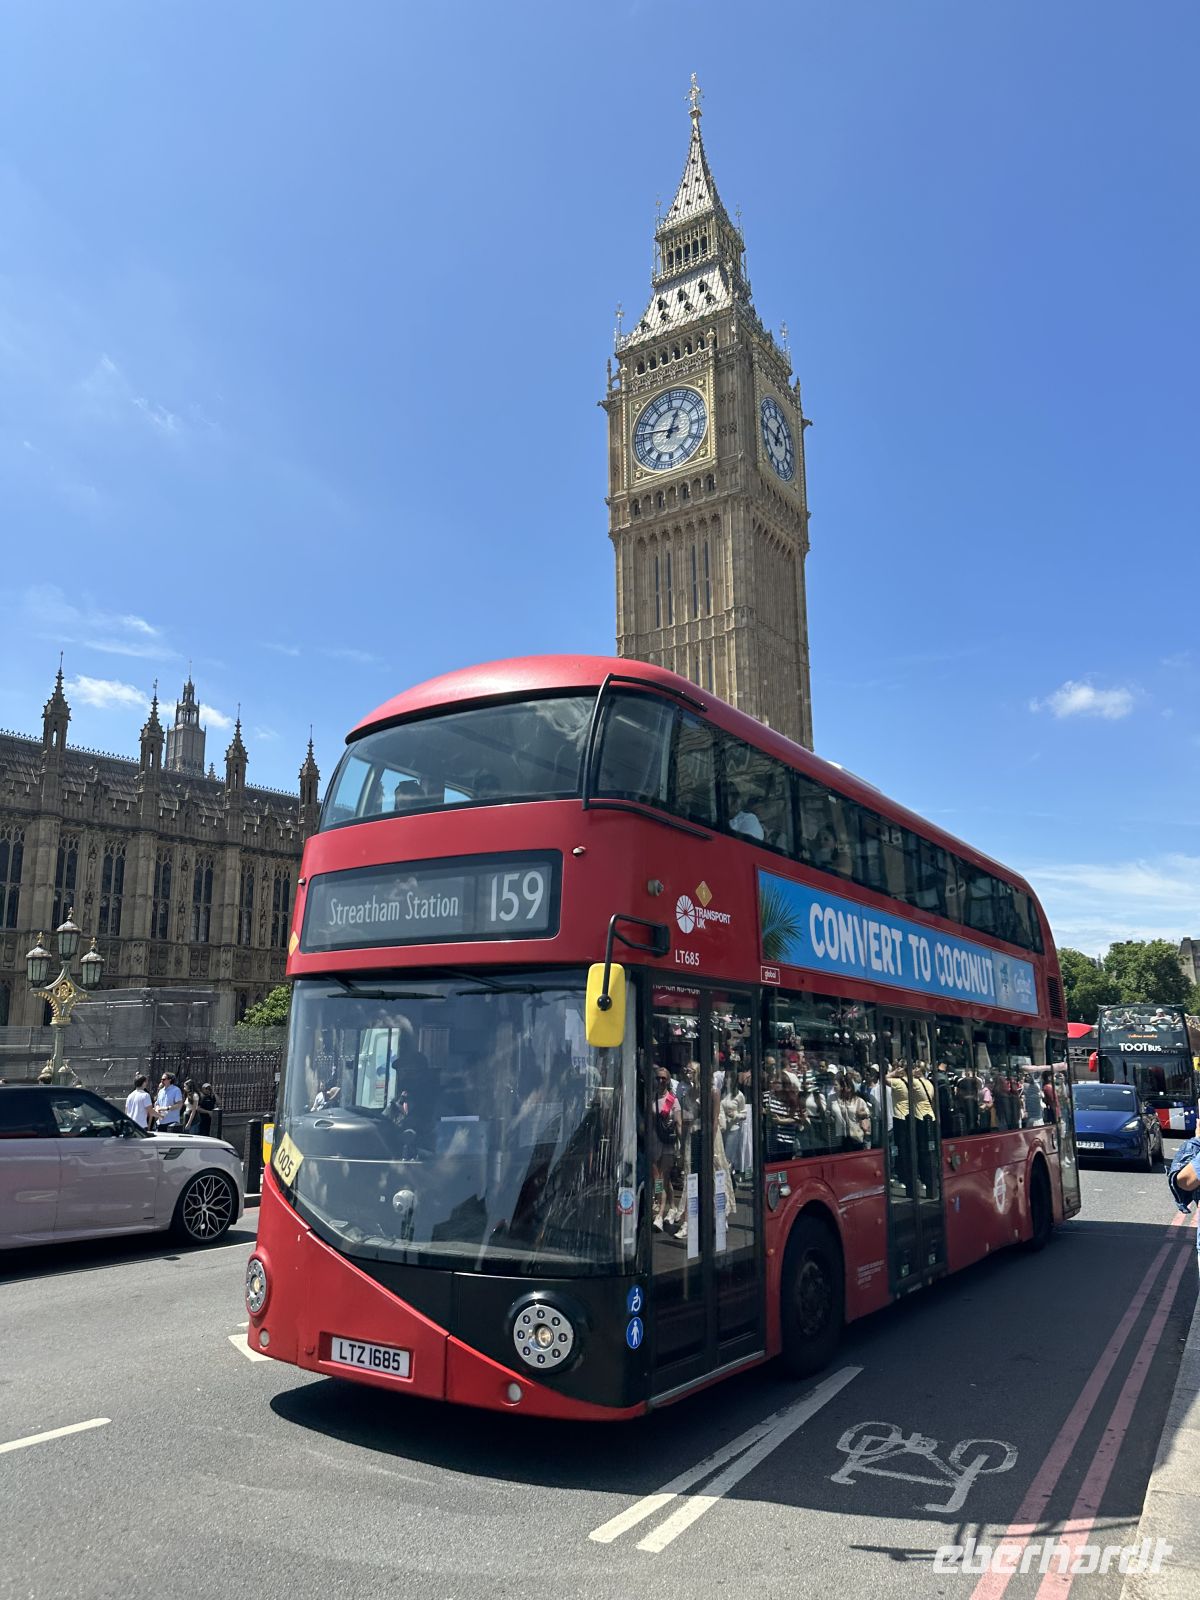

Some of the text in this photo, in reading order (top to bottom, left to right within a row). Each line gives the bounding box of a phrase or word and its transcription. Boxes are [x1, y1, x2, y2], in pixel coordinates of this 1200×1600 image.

[329, 893, 459, 925] Streatham Station
[490, 871, 545, 922] 159
[695, 906, 731, 925] TRANSPORT
[696, 916, 706, 929] UK
[675, 949, 700, 966] LT685
[809, 902, 902, 976] CONVERT
[908, 934, 931, 982] TO
[934, 942, 995, 997] COCONUT
[339, 1340, 401, 1372] LTZ 1685
